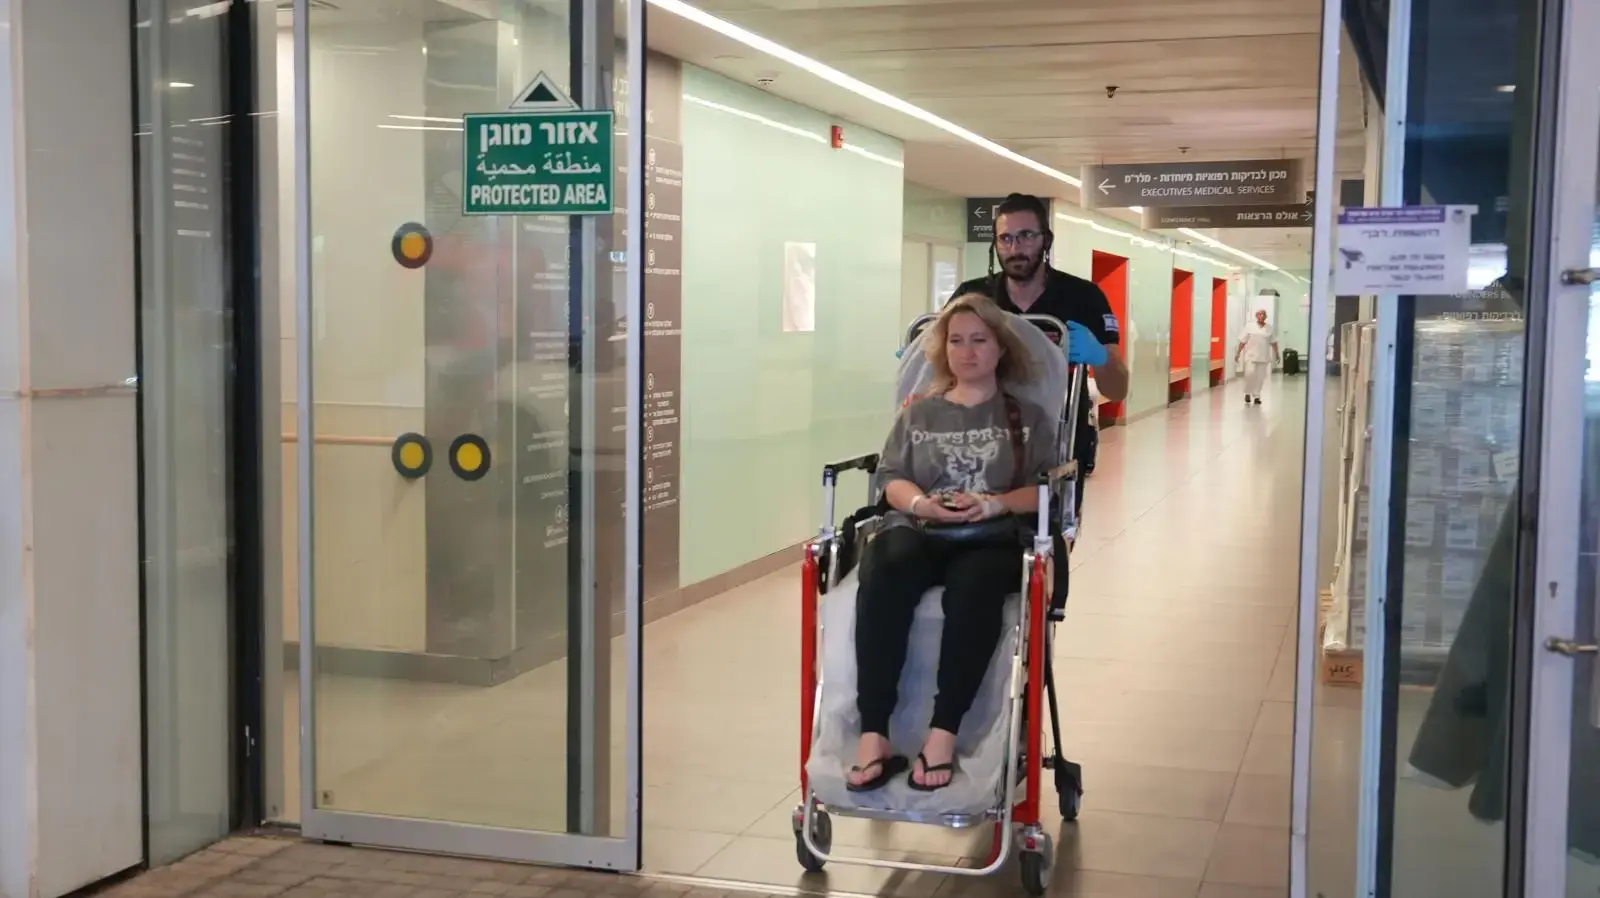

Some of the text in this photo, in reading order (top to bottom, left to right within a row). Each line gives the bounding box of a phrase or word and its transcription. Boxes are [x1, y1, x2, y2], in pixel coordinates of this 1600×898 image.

[479, 121, 598, 153] אזור מוגן
[476, 154, 536, 181] محمية
[542, 152, 602, 174] منطقة
[471, 183, 607, 205] PROTECTED AREA
[1141, 185, 1275, 197] EXECUTIVES MEDICAL SERVICES
[1275, 210, 1298, 221] אולם
